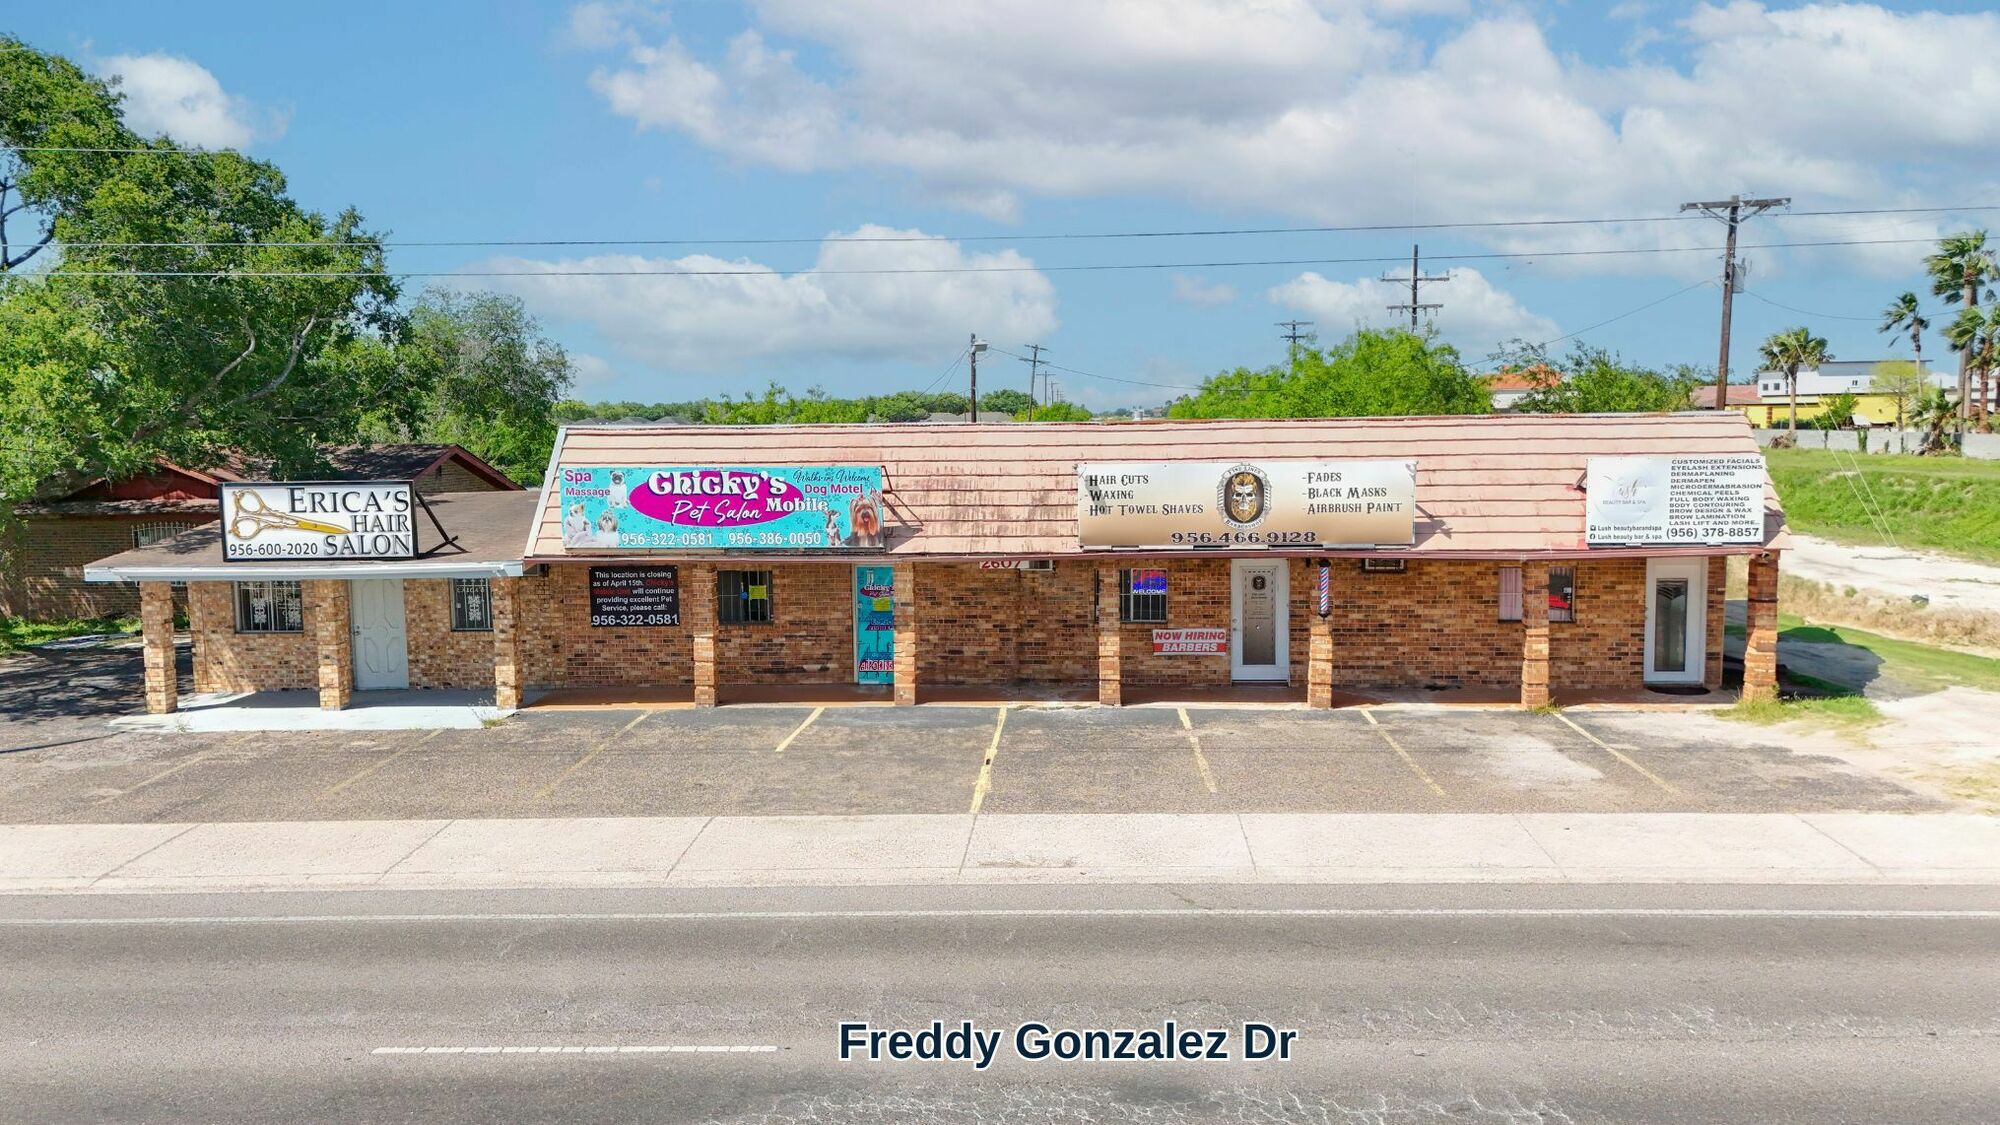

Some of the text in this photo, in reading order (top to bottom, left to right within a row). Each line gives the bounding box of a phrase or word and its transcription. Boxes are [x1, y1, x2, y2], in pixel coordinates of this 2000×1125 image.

[565, 470, 592, 484] Spa
[1121, 474, 1149, 486] CUTS
[648, 471, 788, 500] Chicky's
[805, 483, 863, 495] Dog Motel
[566, 488, 611, 497] Massage
[1347, 487, 1387, 498] MASKS
[287, 487, 409, 513] ERICA'S
[766, 497, 829, 512] Mobile
[671, 499, 762, 526] Pet Salon
[1117, 504, 1158, 516] TOWEL
[1162, 503, 1204, 515] SHAVES
[1366, 502, 1402, 514] PAINT
[351, 514, 410, 533] HAIR
[621, 533, 713, 545] 956-322-0581
[728, 532, 821, 545] 956-386-0050
[1171, 532, 1316, 543] 956.466.9128
[1666, 528, 1759, 539] (956) 378-8857
[229, 543, 318, 555] 956-600-2020
[324, 535, 410, 555] SALON
[647, 571, 672, 579] closing
[610, 580, 627, 588] April
[593, 615, 678, 625] 956-322-0581
[1155, 632, 1225, 640] NOW HIRING
[1162, 643, 1218, 652] BARBERS
